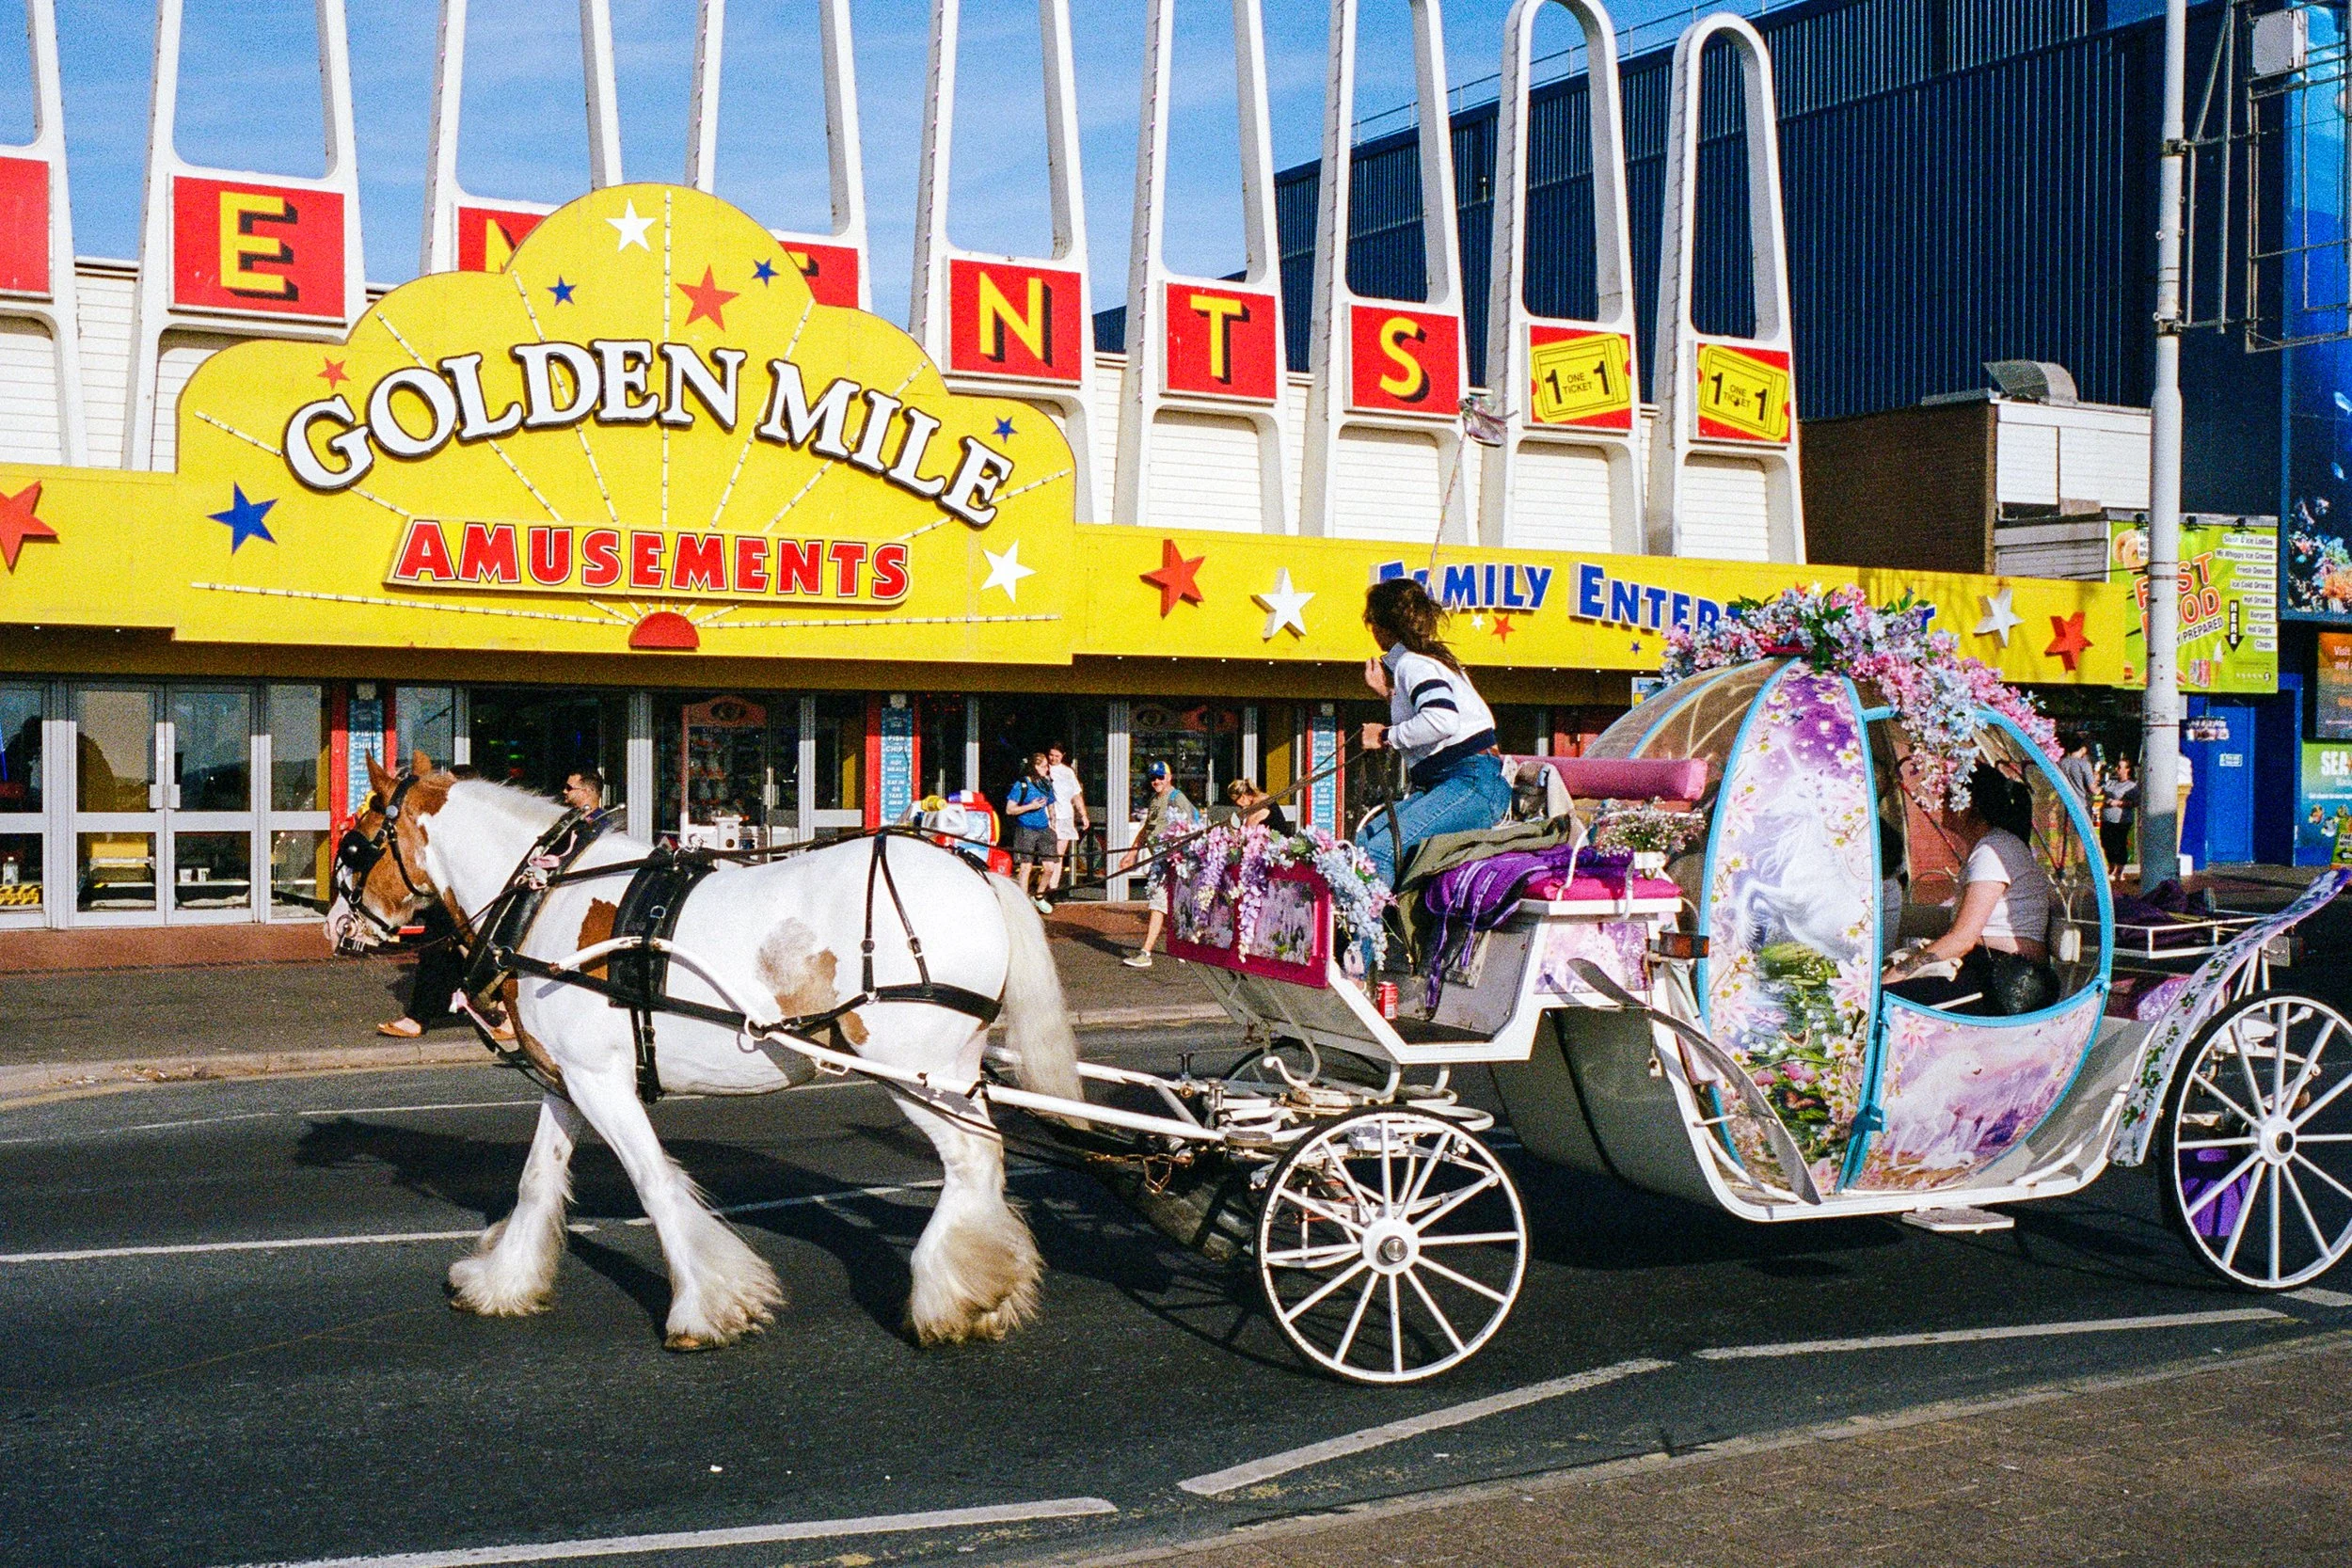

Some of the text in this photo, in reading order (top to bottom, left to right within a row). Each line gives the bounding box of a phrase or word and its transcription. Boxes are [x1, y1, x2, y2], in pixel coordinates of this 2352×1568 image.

[1545, 369, 1563, 405] 1
[1562, 381, 1593, 394] TICKET
[1566, 372, 1586, 384] ONE
[1594, 360, 1610, 395] 1
[1710, 372, 1724, 405] 1
[1729, 384, 1747, 397] ONE
[1755, 388, 1768, 421] 1
[282, 339, 1015, 530] GOLDEN MILE
[393, 519, 909, 599] AMUSEMENTS
[2135, 553, 2212, 610] FST
[2183, 617, 2224, 643] PREPARED
